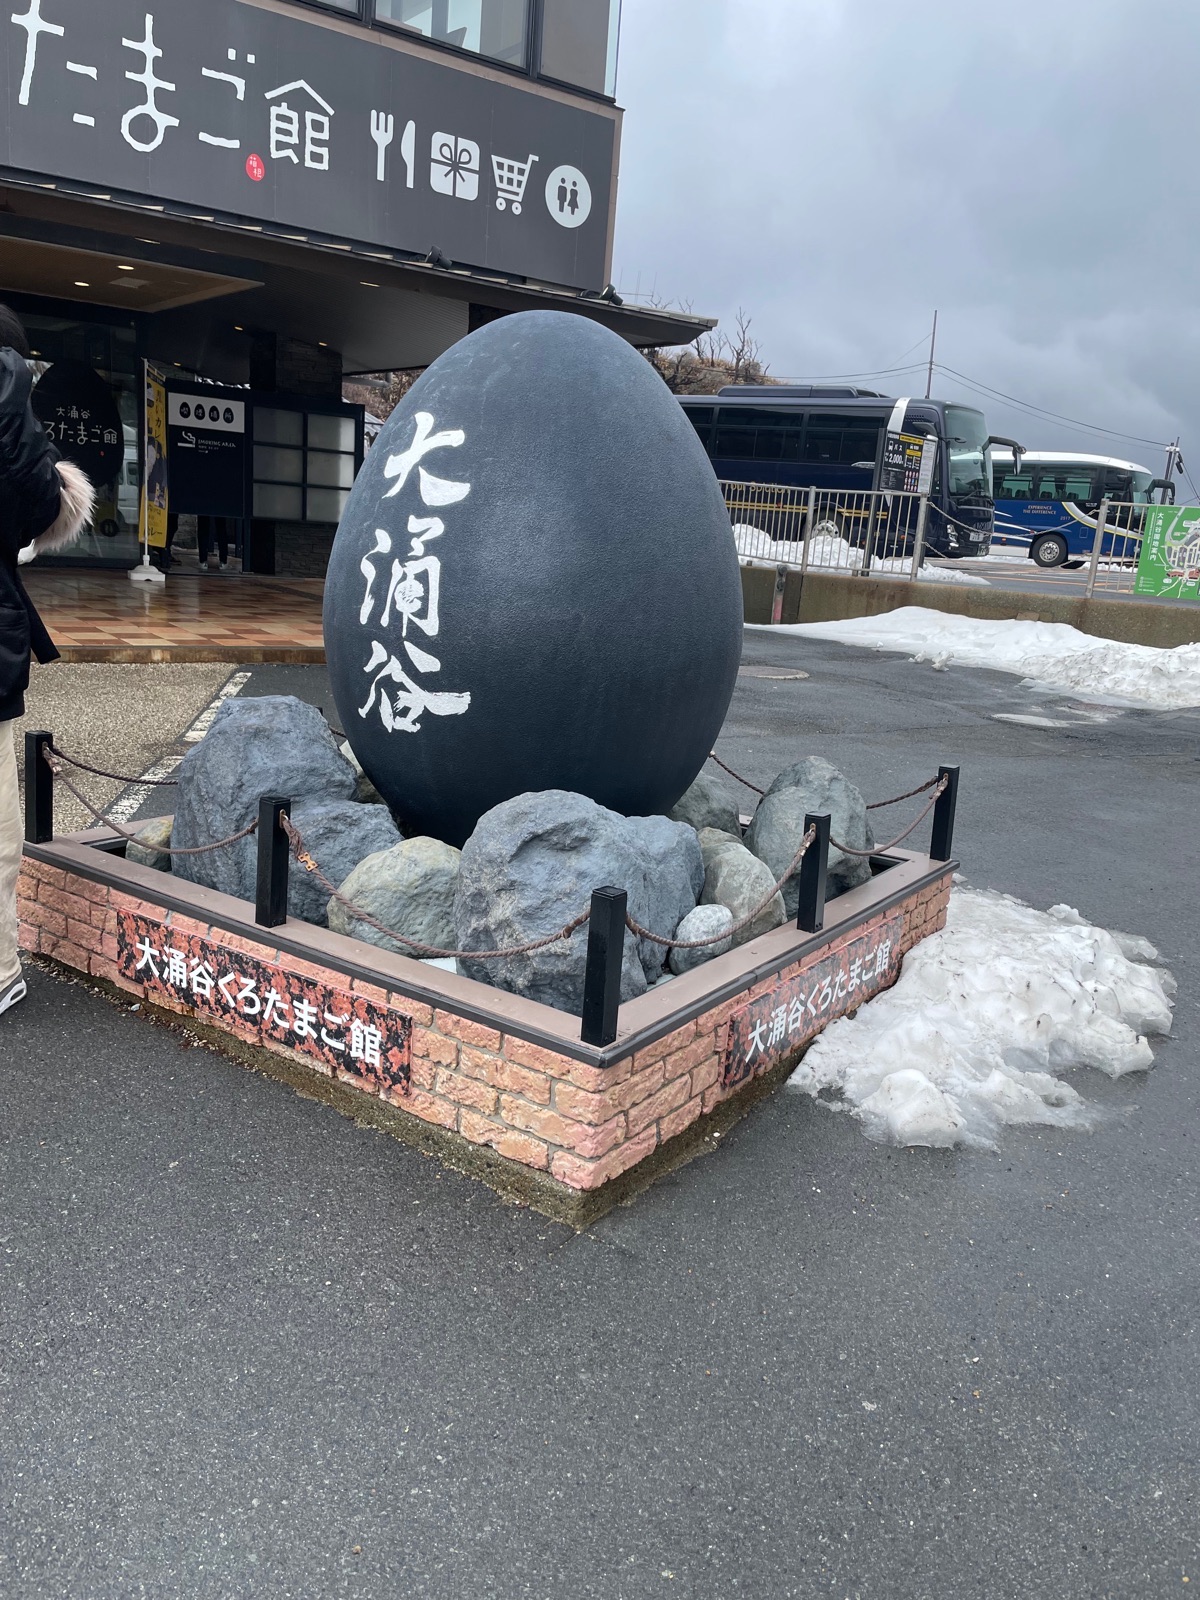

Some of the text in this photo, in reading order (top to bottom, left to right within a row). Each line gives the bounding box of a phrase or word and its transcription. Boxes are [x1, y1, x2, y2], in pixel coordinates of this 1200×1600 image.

[11, 0, 335, 171] たまご館
[43, 421, 118, 445] ろたまご館
[56, 406, 90, 419] 大涌谷
[358, 411, 472, 733] 大涌谷
[134, 936, 382, 1068] 大涌谷くろたまご館
[745, 938, 892, 1063] 大涌谷くろたまご館
